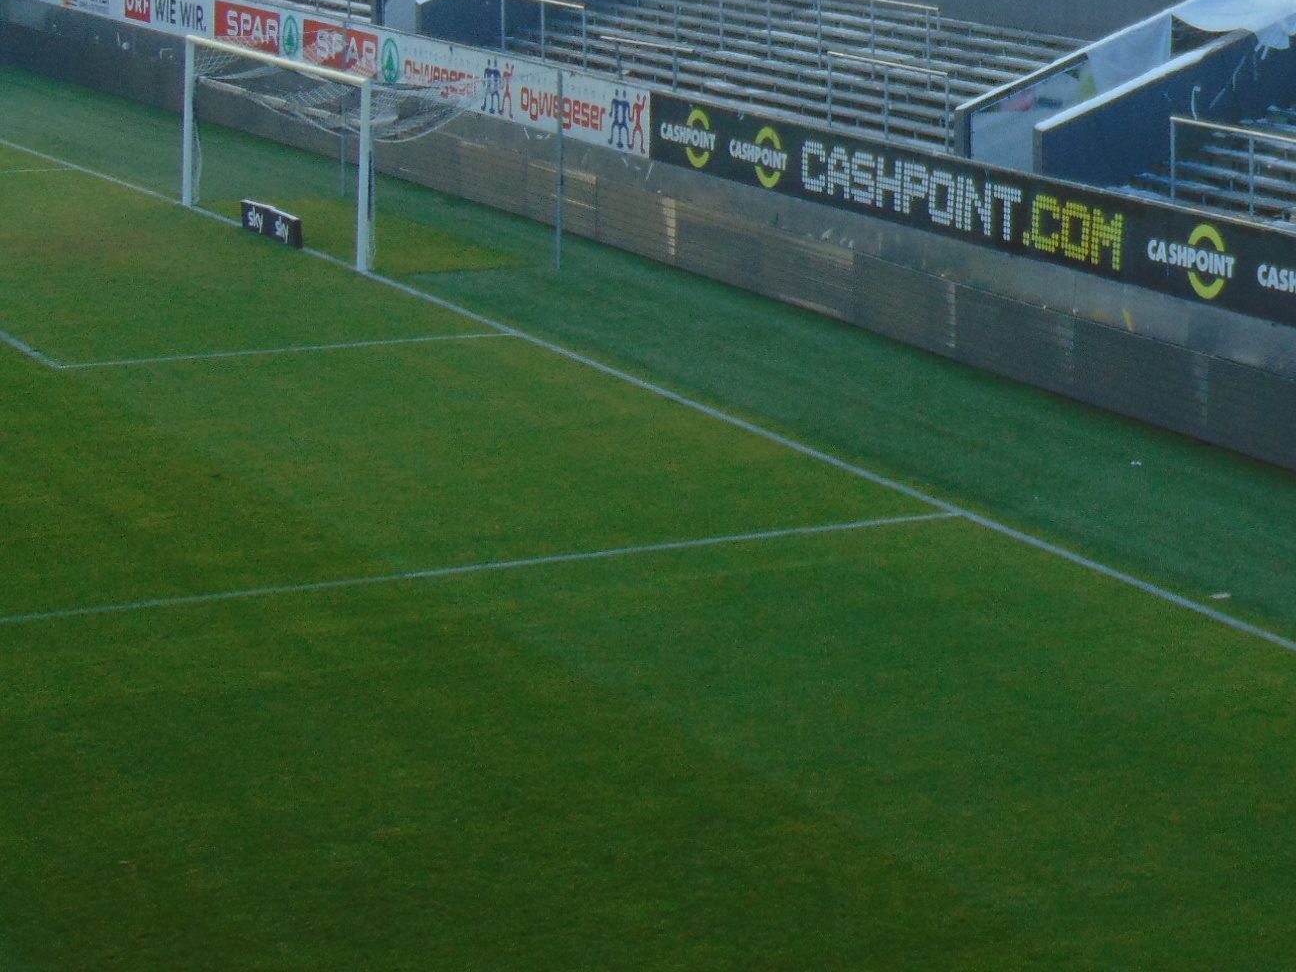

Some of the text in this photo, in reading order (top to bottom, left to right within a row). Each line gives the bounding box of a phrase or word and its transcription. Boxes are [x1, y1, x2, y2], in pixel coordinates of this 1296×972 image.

[179, 0, 208, 32] WIR.
[226, 9, 280, 46] SPAR
[316, 29, 377, 68] SPAR
[520, 86, 607, 130] obwegeser
[660, 121, 717, 151] CASHPOINT
[728, 138, 788, 171] CASHPOINT
[1146, 239, 1235, 279] CASHPOINT
